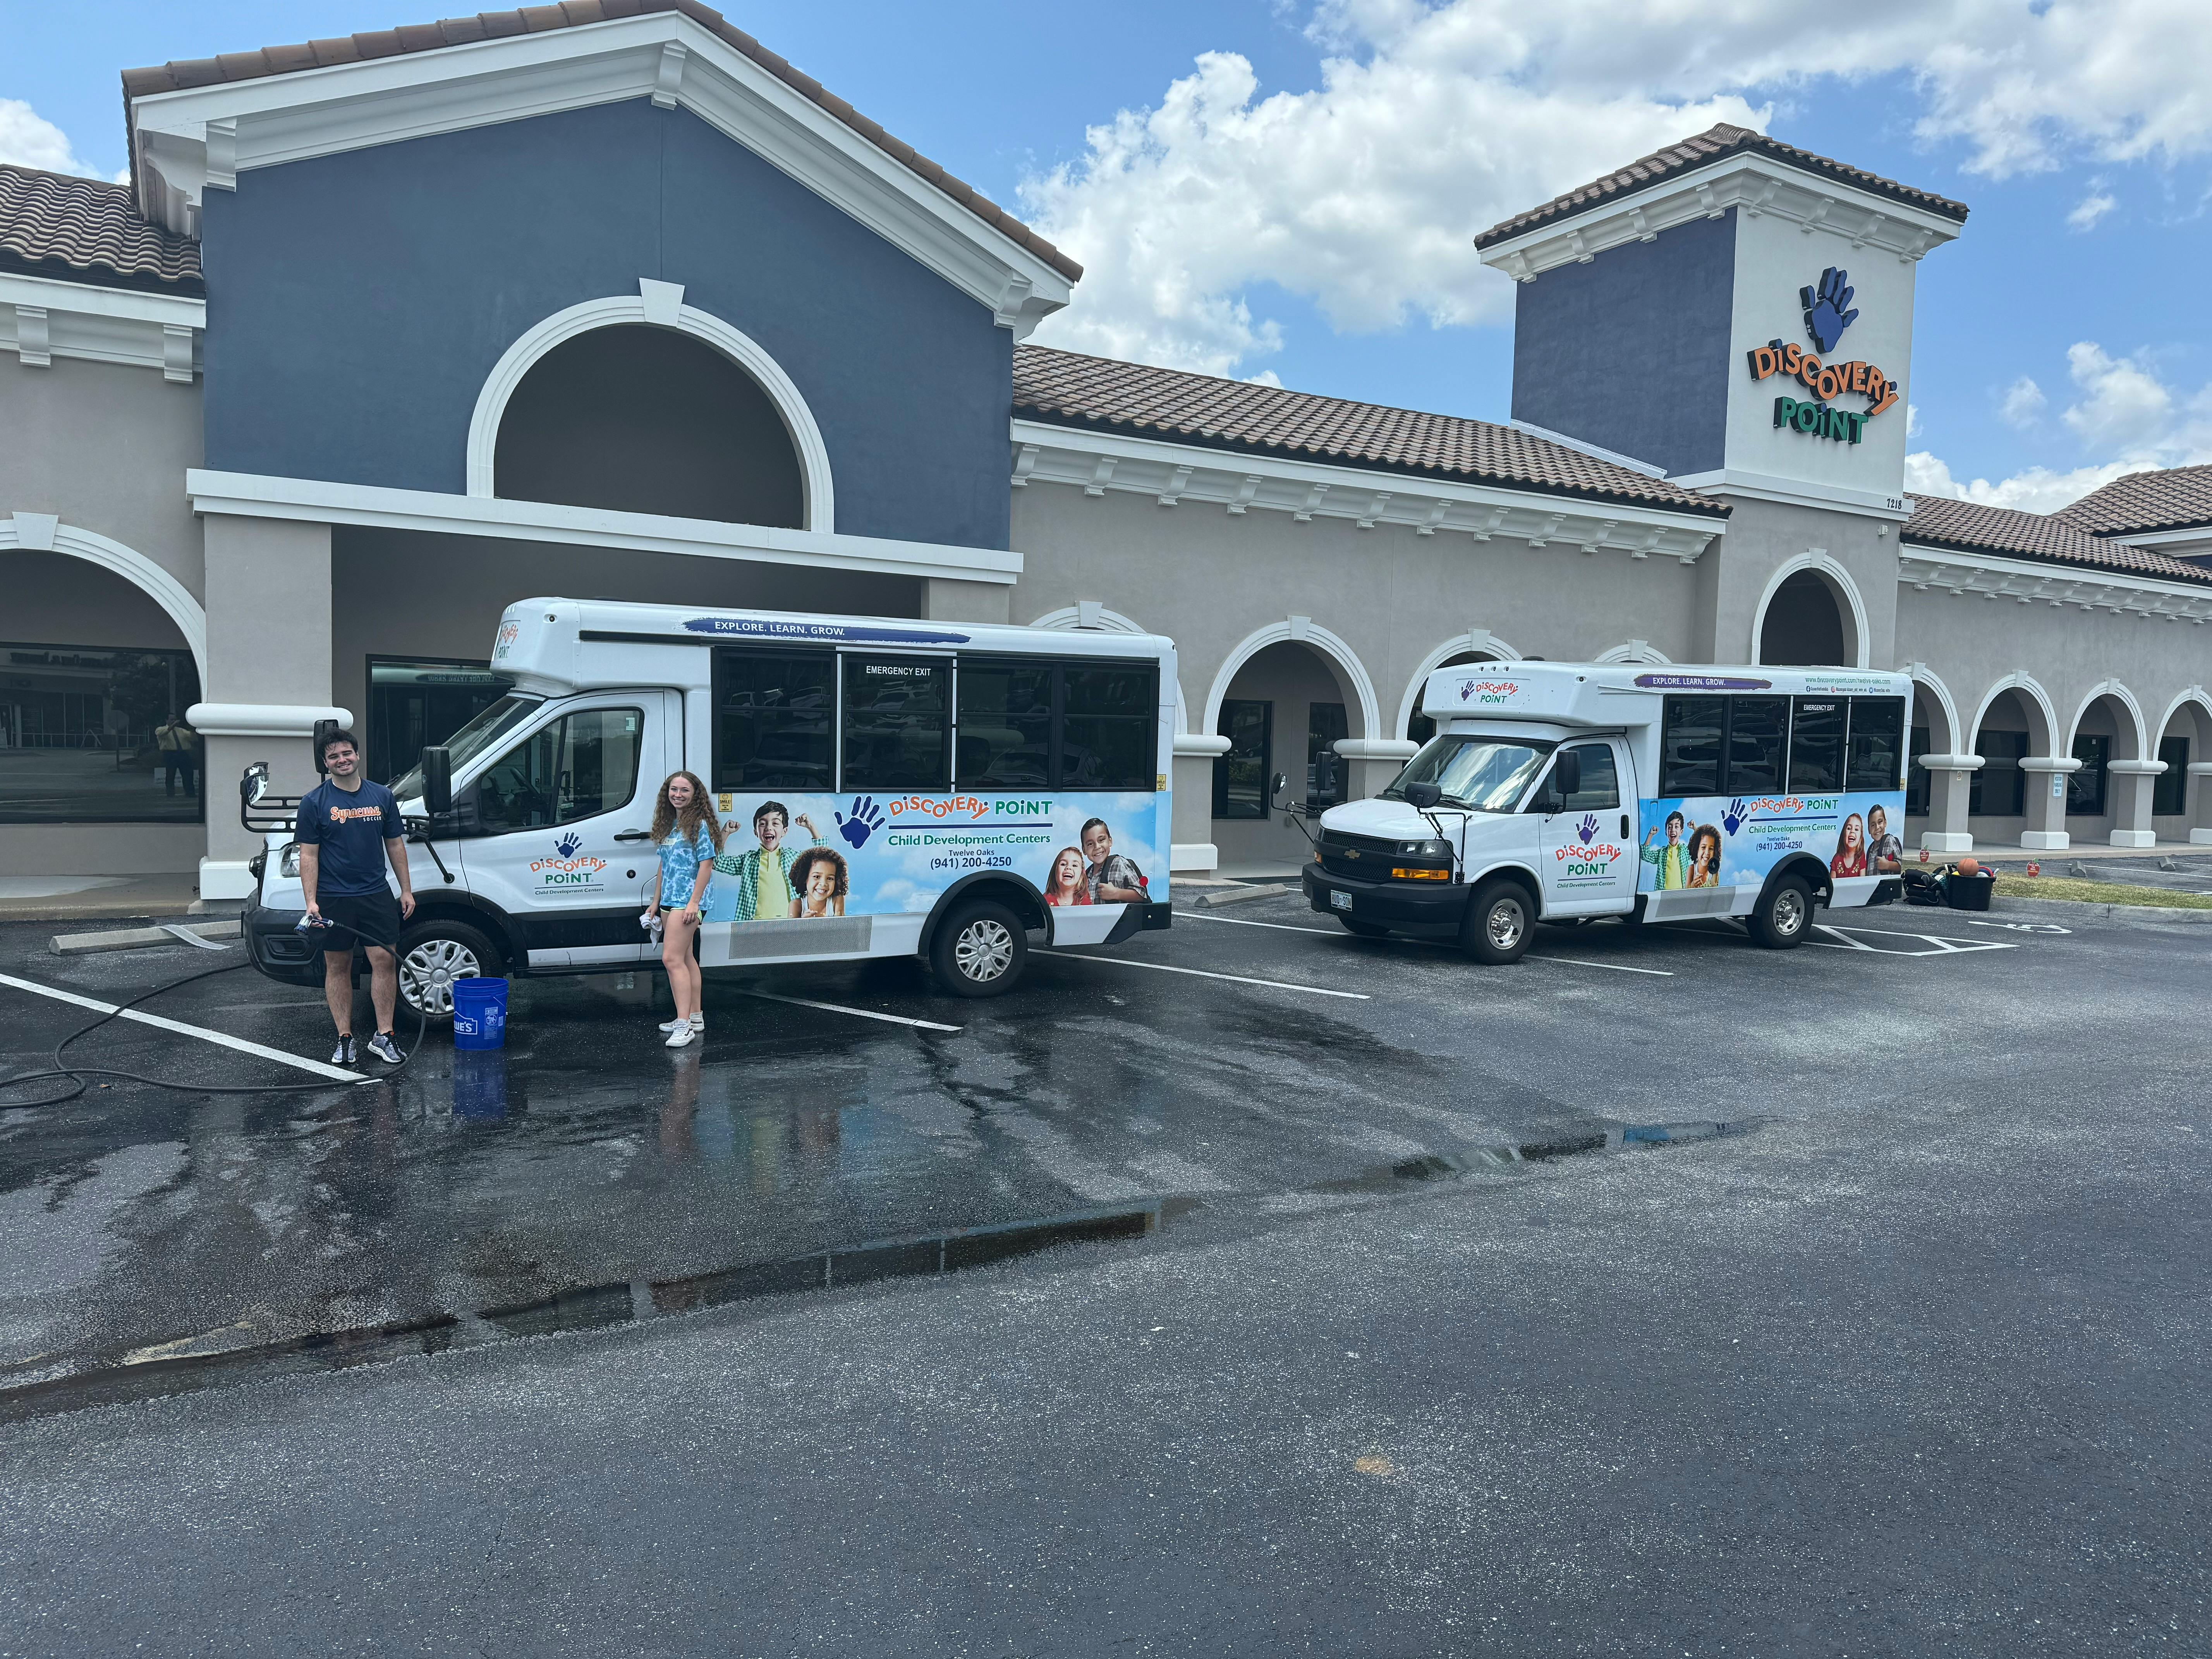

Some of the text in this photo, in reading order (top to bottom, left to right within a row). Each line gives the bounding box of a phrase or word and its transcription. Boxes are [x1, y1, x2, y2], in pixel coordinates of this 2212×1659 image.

[1887, 498, 1902, 509] 7218
[714, 622, 845, 635] EXPLORE. LEARN. GROW.
[866, 666, 913, 675] EMERGENCY
[331, 806, 381, 823] Syracuse
[1768, 825, 1810, 833] Development
[888, 833, 1050, 847] Child Development Centers
[1756, 841, 1802, 852] (941) 200-4250
[931, 857, 1012, 869] (941) 200-4250
